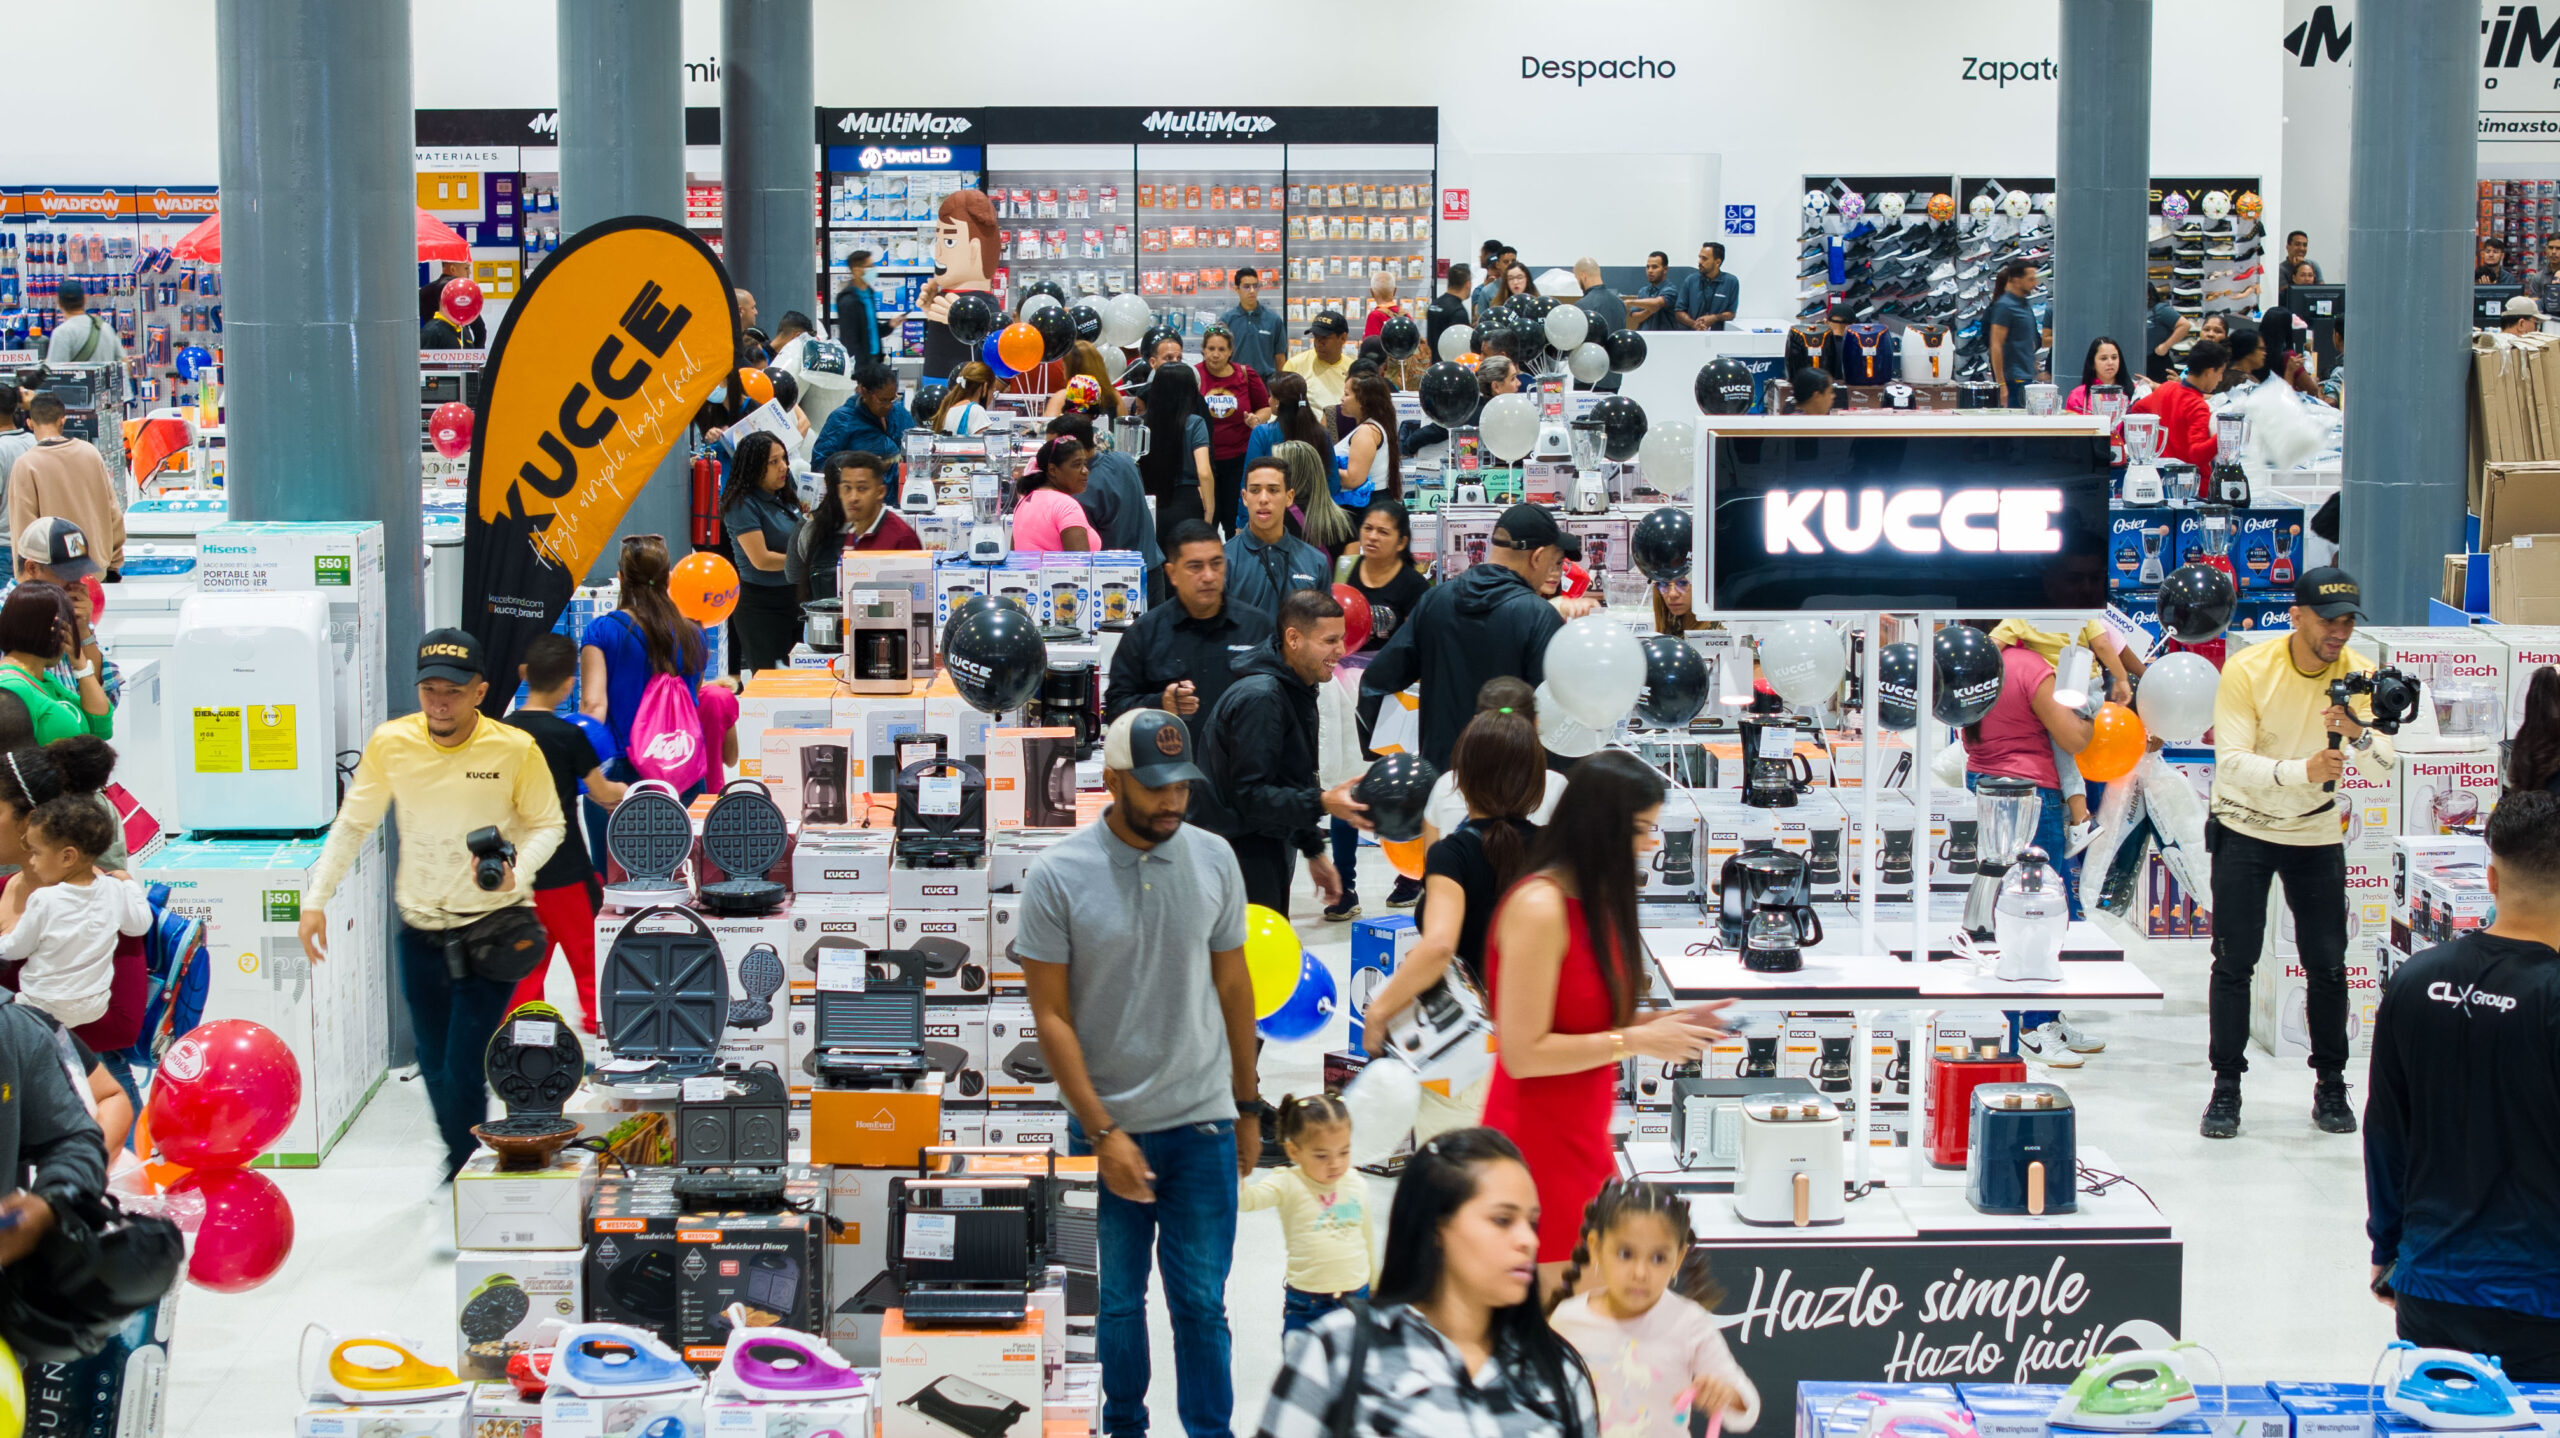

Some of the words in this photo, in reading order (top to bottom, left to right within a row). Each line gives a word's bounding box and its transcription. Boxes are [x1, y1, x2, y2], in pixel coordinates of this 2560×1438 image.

[1521, 55, 1676, 86] Despacho
[844, 112, 961, 133] MultiMax
[1148, 111, 1267, 132] MultiMax
[415, 152, 499, 161] MATERIALES
[41, 198, 119, 211] WADFOW
[1077, 319, 1098, 330] KUCCE
[433, 353, 486, 361] CONDESA
[1719, 385, 1751, 394] KUCCE
[1206, 396, 1234, 405] POLAR
[492, 279, 693, 534] KUCCE
[769, 402, 791, 431] DAEWOO
[1766, 489, 2063, 554] KUCCE
[2113, 518, 2147, 534] Oster
[2245, 518, 2278, 534] Oster
[203, 544, 257, 554] Hisense
[318, 558, 342, 569] 550
[203, 570, 249, 579] PORTABLE
[421, 643, 469, 659] KUCCE
[950, 655, 993, 679] KUCCE
[1774, 659, 1816, 677] KUCCE
[1954, 677, 1999, 699] KUCCE
[2413, 762, 2495, 776] Hamilton
[466, 771, 500, 779] KUCCE
[825, 871, 858, 879] KUCCE
[2345, 875, 2388, 887] each
[923, 886, 956, 895] KUCCE
[196, 906, 212, 915] AIR
[822, 923, 855, 932] KUCCE
[922, 924, 956, 933] KUCCE
[2471, 990, 2518, 1013] Group
[924, 1026, 957, 1036] UCCE
[856, 1119, 893, 1129] HomEver
[1019, 1134, 1052, 1143] KUCCE
[605, 1221, 640, 1230] WESTPOOL
[634, 1232, 676, 1241] Sandwiche
[686, 1232, 716, 1240] WESTPOOL
[710, 1242, 761, 1251] Sandwichera
[762, 1242, 789, 1252] Disney
[1720, 1267, 1902, 1343] Hazlo
[1918, 1256, 2091, 1343] simple
[886, 1355, 925, 1365] HomEver
[1884, 1331, 2005, 1383] Hazlo
[1995, 1425, 2039, 1434] Westinghouse
[2262, 1422, 2284, 1438] Steam
[2316, 1424, 2360, 1433] Westinghouse
